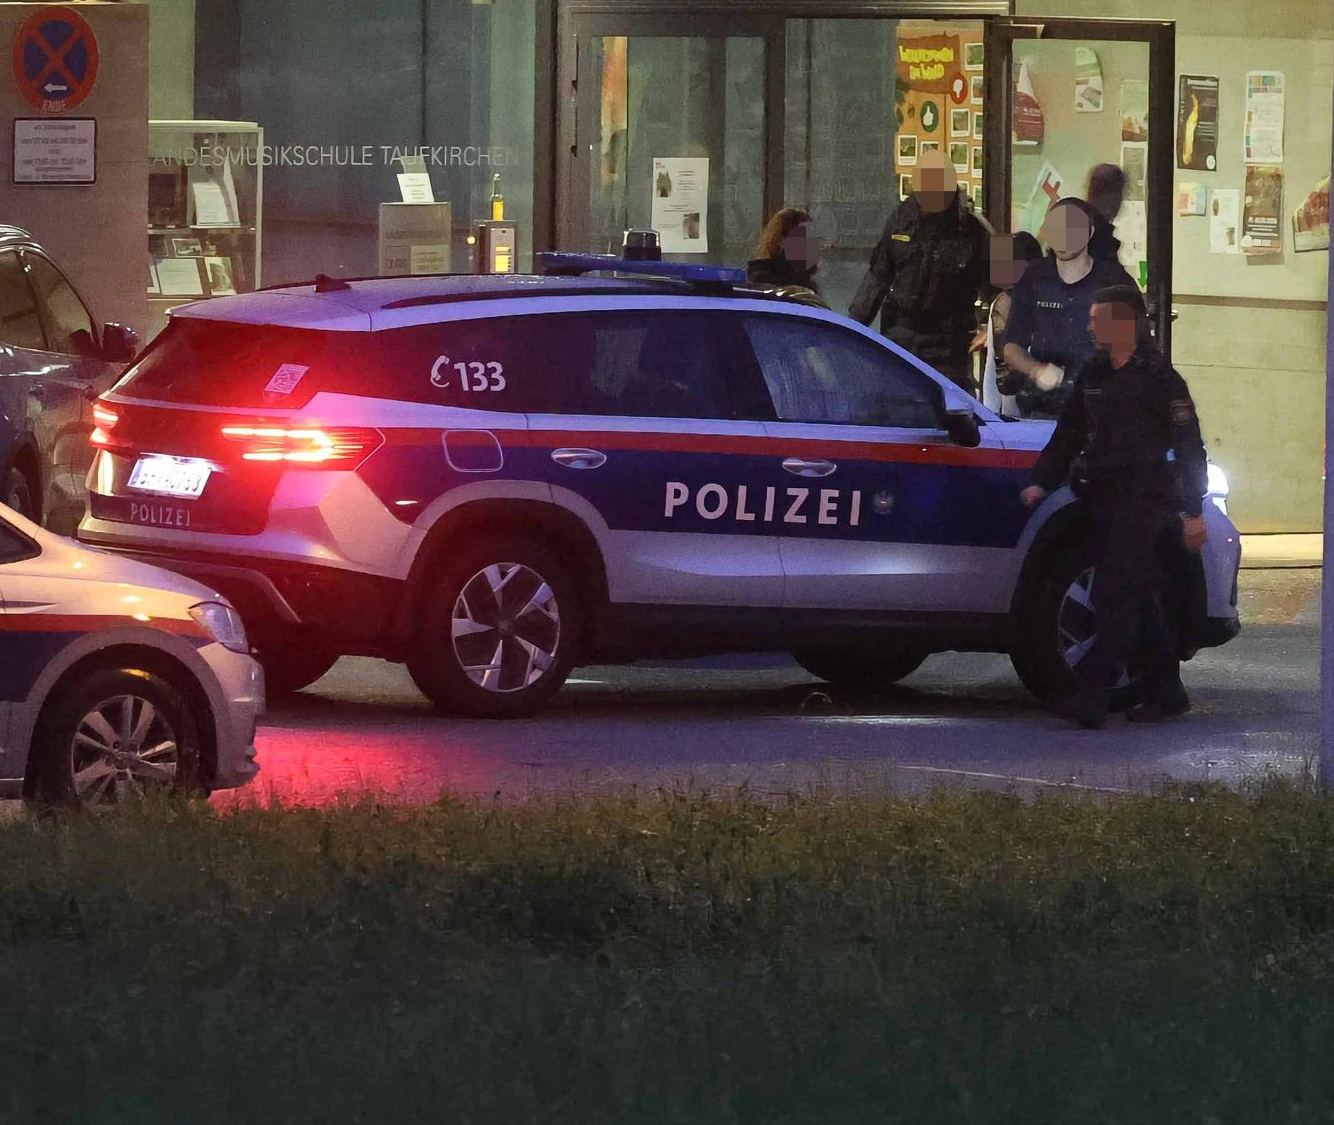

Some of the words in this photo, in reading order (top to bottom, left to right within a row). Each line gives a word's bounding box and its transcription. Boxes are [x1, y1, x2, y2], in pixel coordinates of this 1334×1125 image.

[143, 145, 374, 167] ANDESMUSIKSCHULE
[453, 361, 506, 392] 133
[130, 502, 192, 527] POLIZEI
[663, 481, 862, 527] POLIZEI
